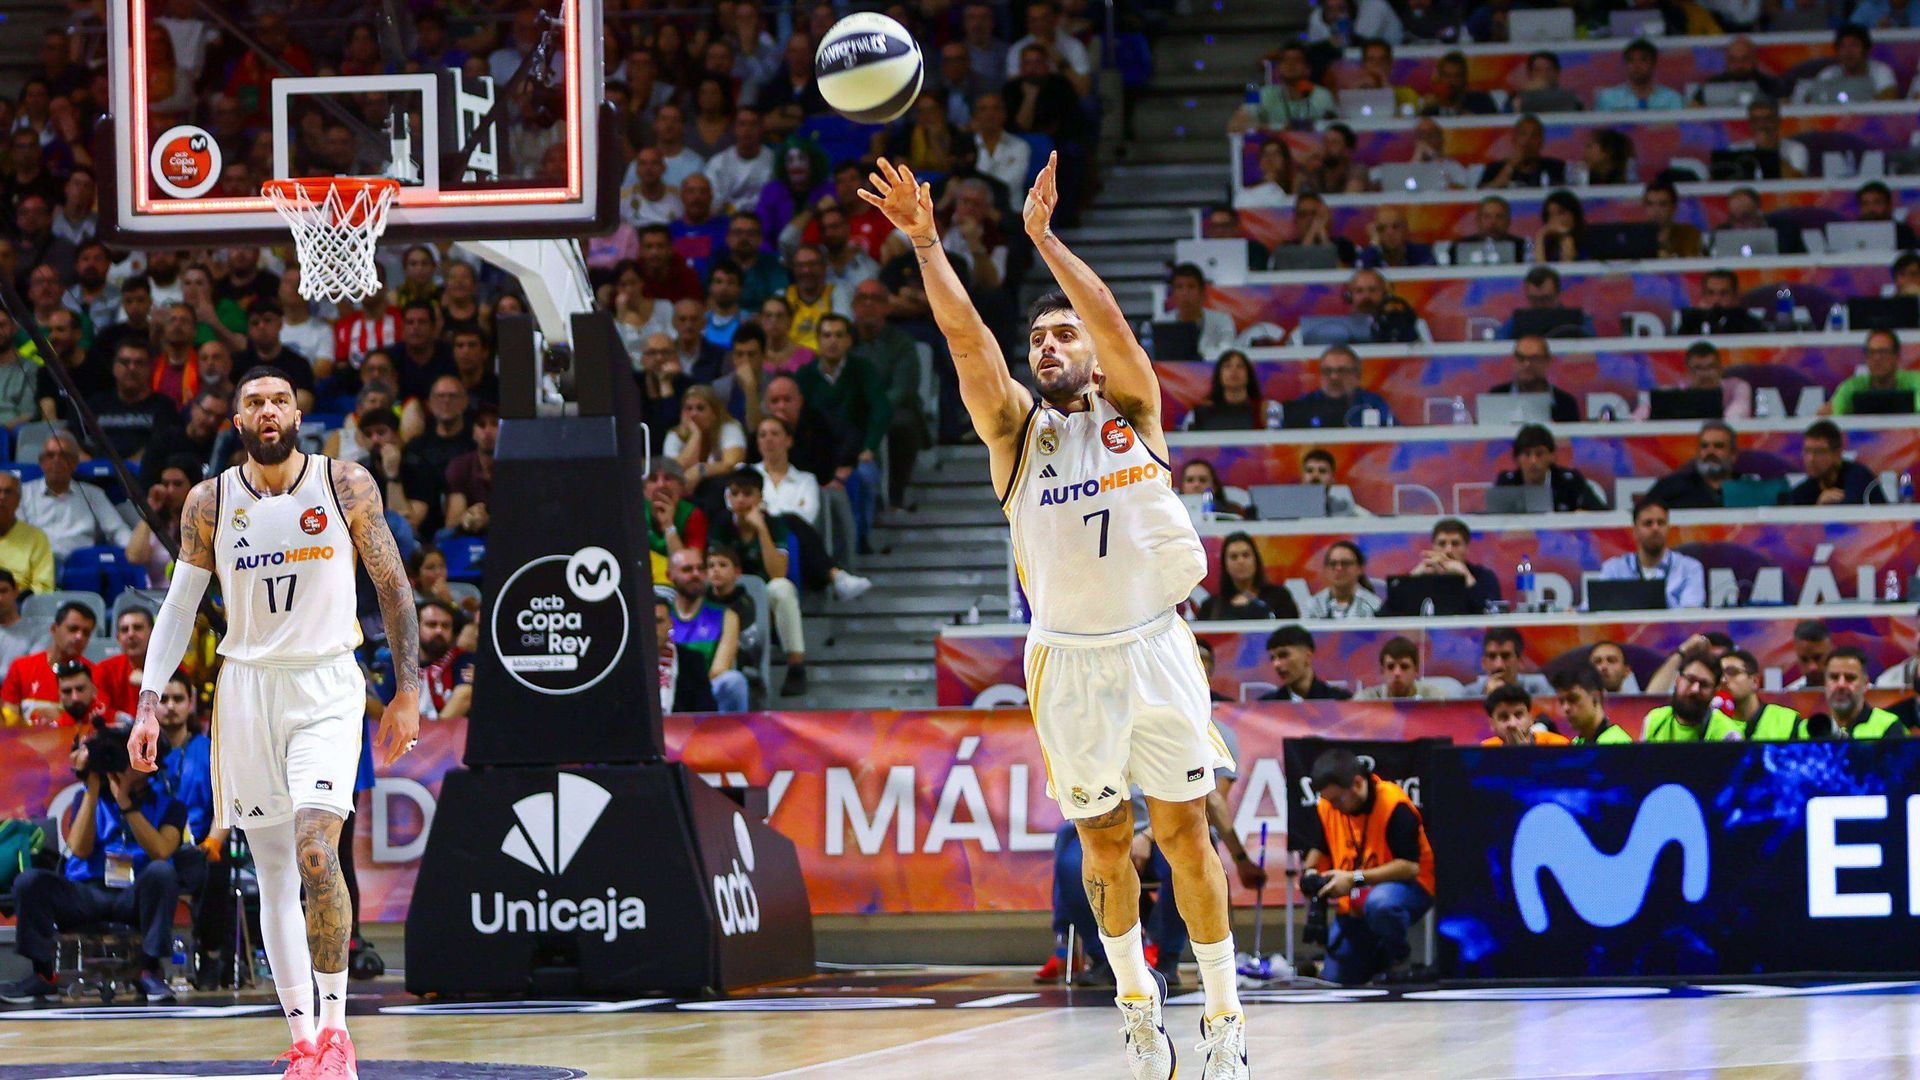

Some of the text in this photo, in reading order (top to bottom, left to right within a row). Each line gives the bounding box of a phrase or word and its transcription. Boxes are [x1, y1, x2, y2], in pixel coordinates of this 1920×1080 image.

[169, 157, 195, 167] Copa
[1039, 463, 1159, 507] AUTOHERO
[1083, 508, 1110, 559] 7
[235, 546, 334, 571] AUTOHERO
[262, 574, 297, 614] 17
[530, 594, 565, 611] acb
[517, 609, 582, 633] Copa
[521, 633, 591, 657] del Rey
[1188, 773, 1202, 781] acb
[713, 858, 759, 936] acb
[471, 886, 646, 943] Unicaja
